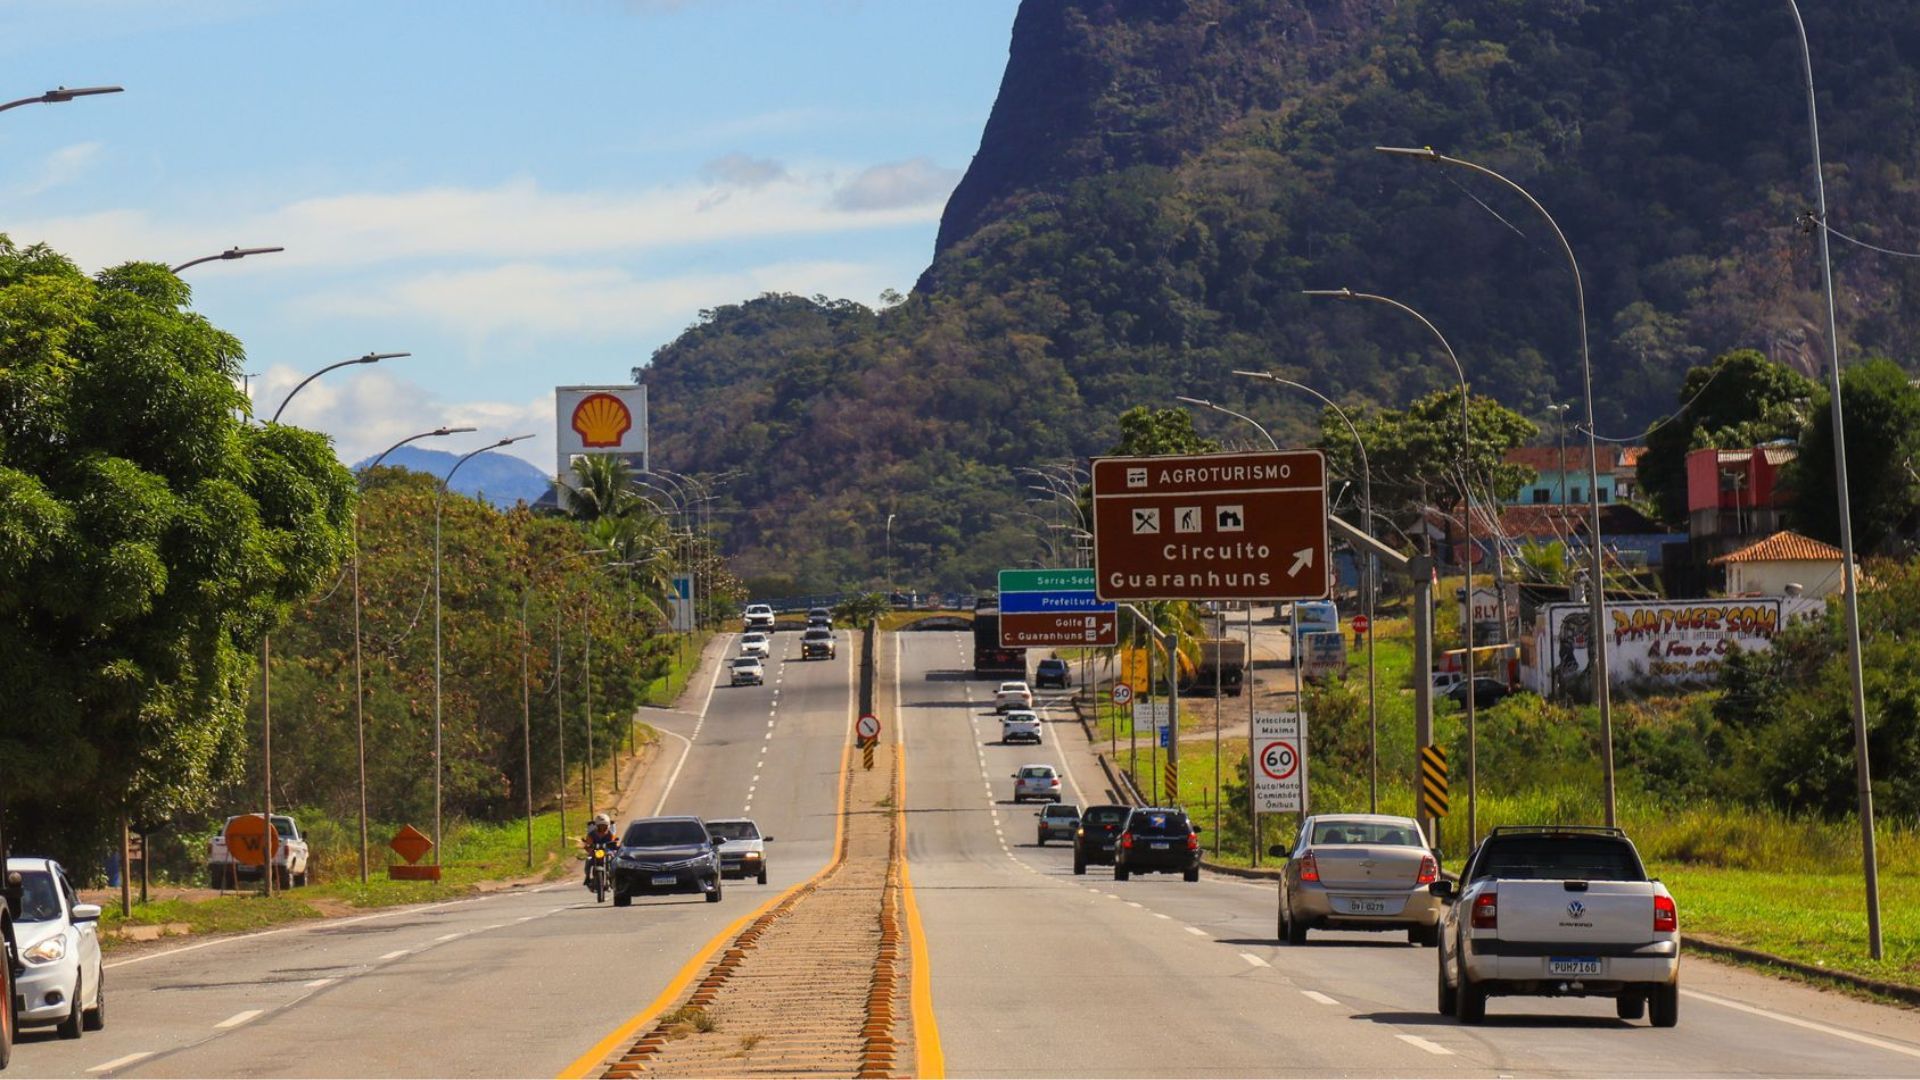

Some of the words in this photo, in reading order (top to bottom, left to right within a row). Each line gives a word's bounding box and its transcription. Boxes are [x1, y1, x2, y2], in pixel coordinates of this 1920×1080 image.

[1159, 464, 1291, 484] AGROTURISMO
[1163, 542, 1270, 560] Circuito
[1110, 570, 1271, 588] Guaranhuns
[1042, 597, 1096, 606] Prefeitura
[1055, 618, 1083, 627] Golfe
[1018, 631, 1083, 640] Guaranhuns
[1266, 750, 1292, 767] 60
